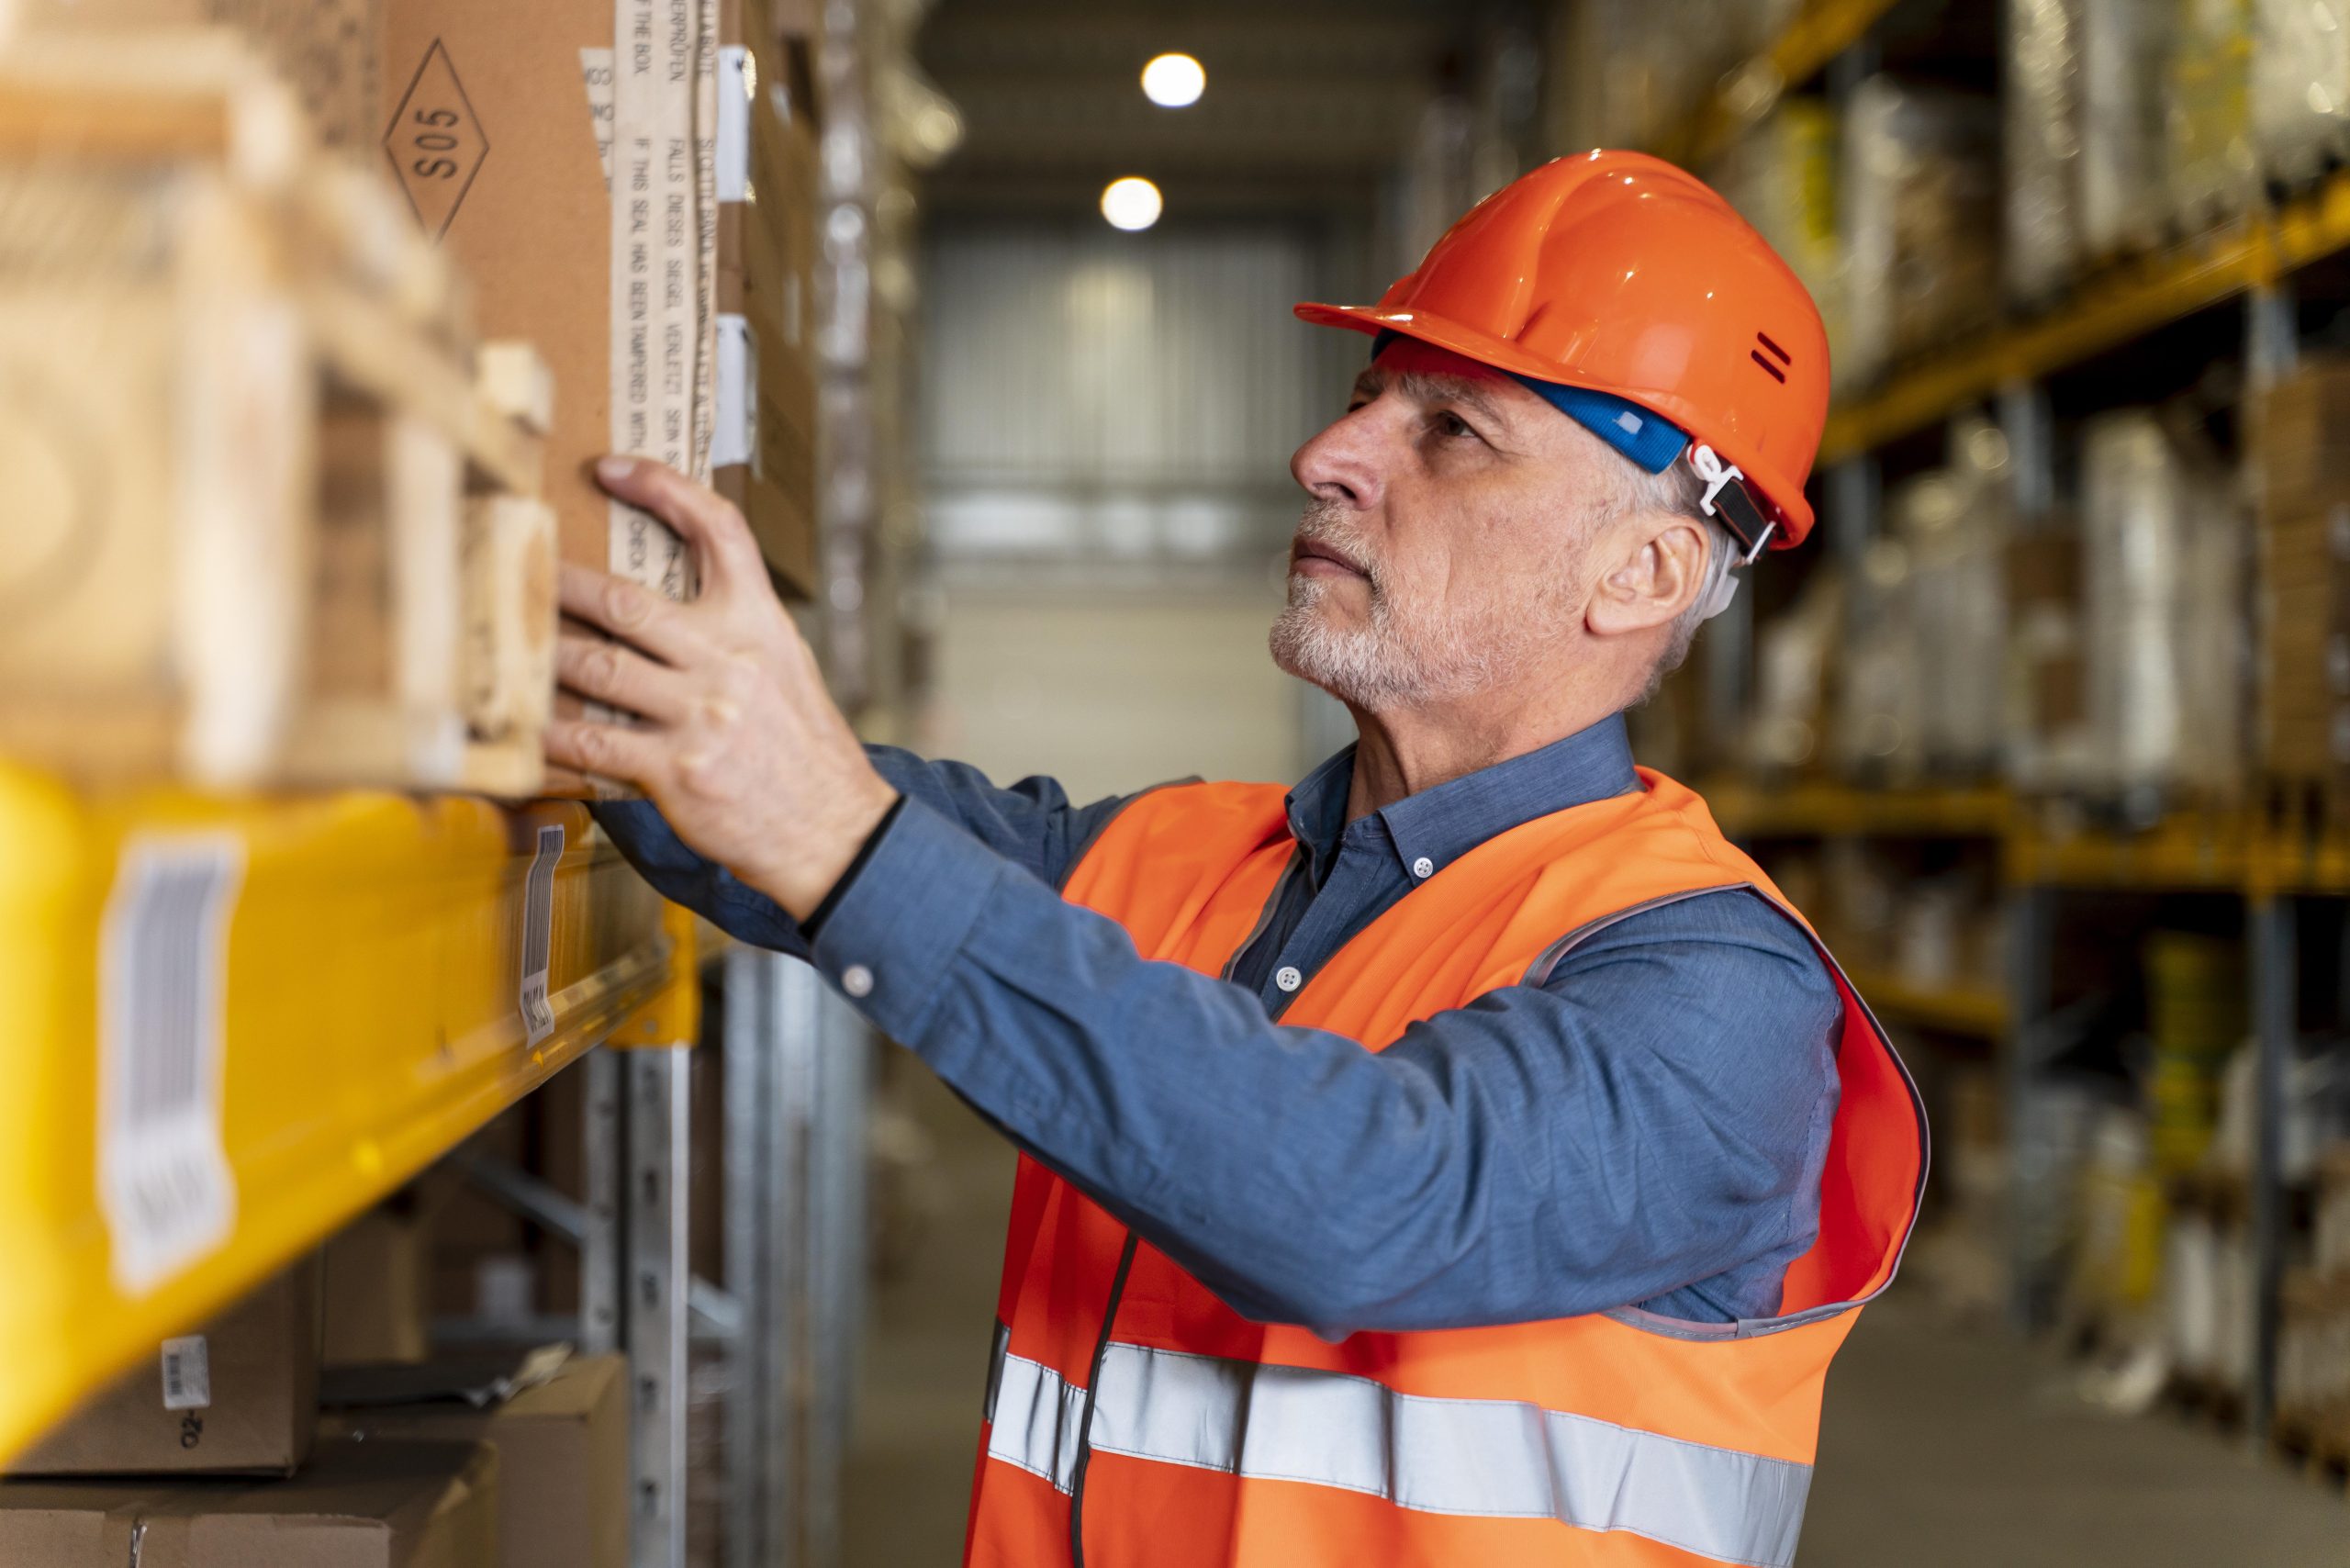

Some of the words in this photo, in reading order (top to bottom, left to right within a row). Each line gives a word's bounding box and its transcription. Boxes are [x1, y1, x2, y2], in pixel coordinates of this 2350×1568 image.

[634, 11, 653, 39] THE
[669, 0, 692, 82] ERPRÜFEN
[633, 138, 653, 151] IF
[667, 139, 686, 184] FALLS
[632, 159, 652, 192] THIS
[631, 198, 651, 233] SEAL
[667, 194, 685, 248] DIESES
[631, 241, 650, 274] HAS
[631, 280, 649, 320] BEEN
[630, 323, 649, 404] TAMPERED
[665, 409, 683, 442] SEIN
